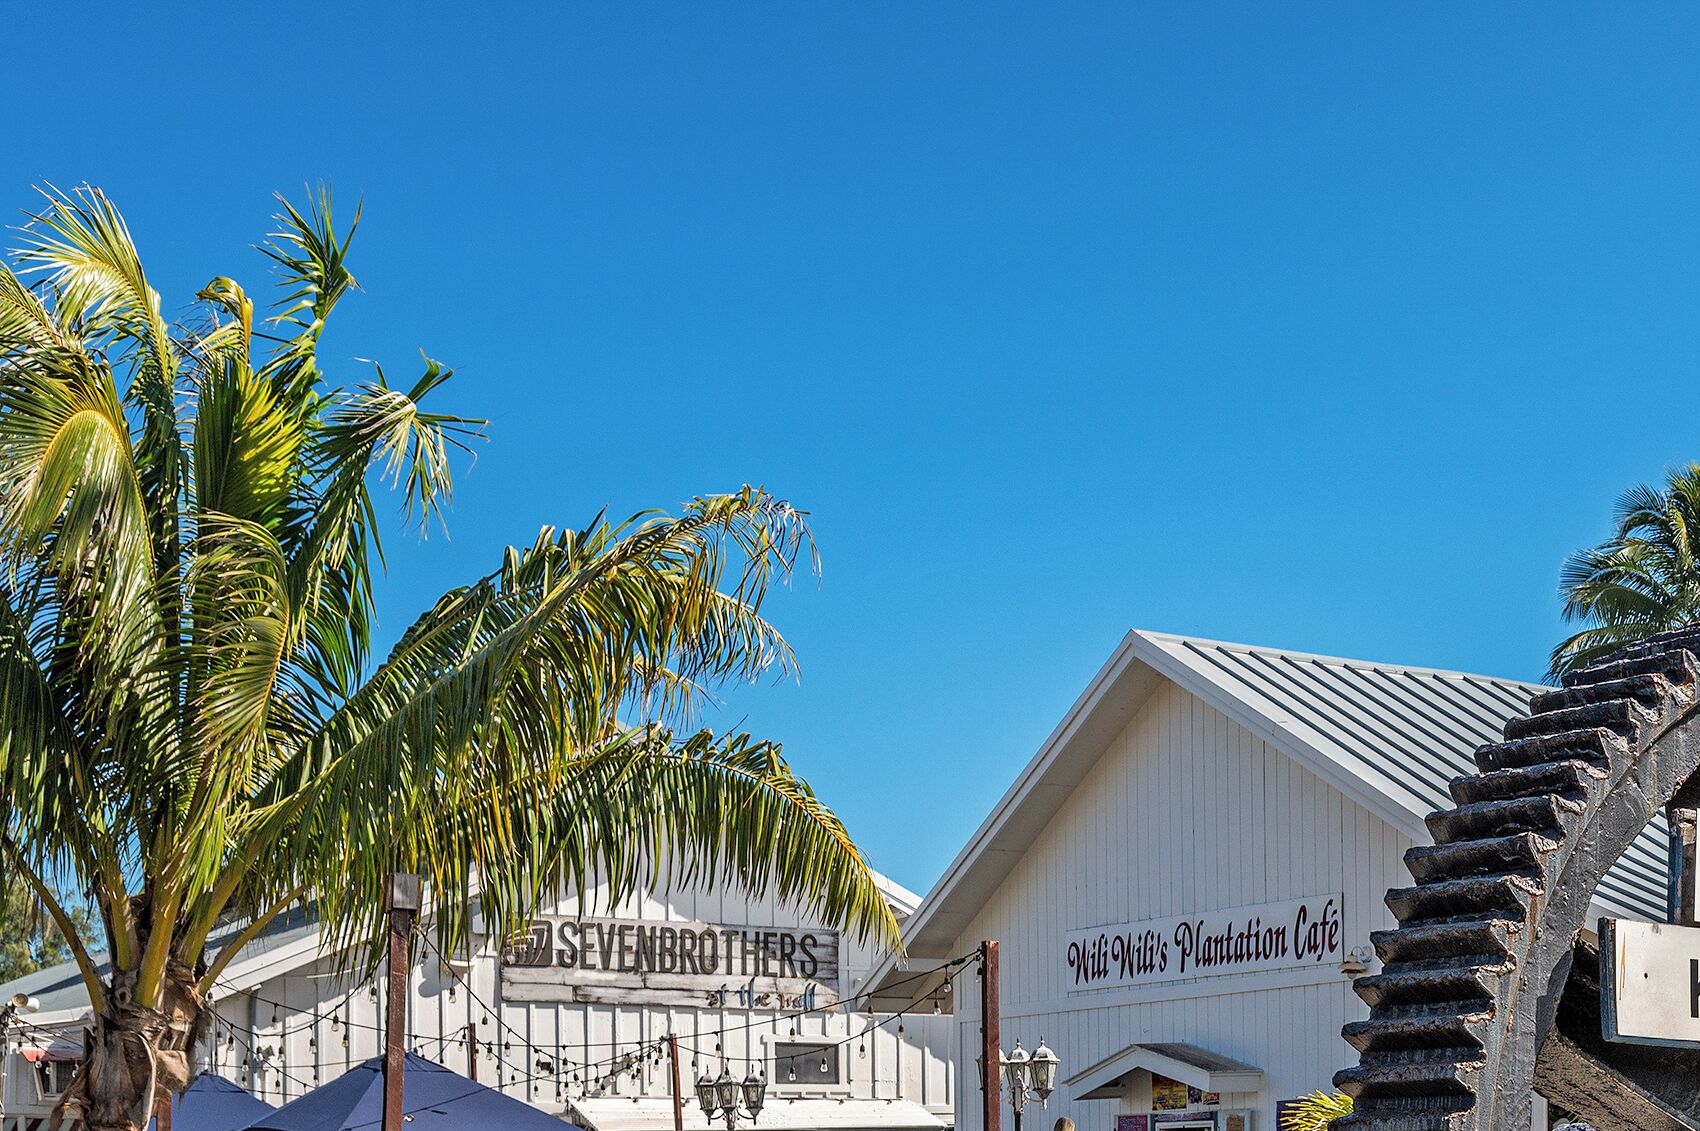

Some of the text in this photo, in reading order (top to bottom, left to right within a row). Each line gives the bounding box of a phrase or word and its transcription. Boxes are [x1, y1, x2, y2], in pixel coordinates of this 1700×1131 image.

[556, 920, 819, 979] SEVENBROTHERS
[1067, 898, 1340, 986] Wili Wili's Plantation Café
[739, 977, 772, 1009] the
